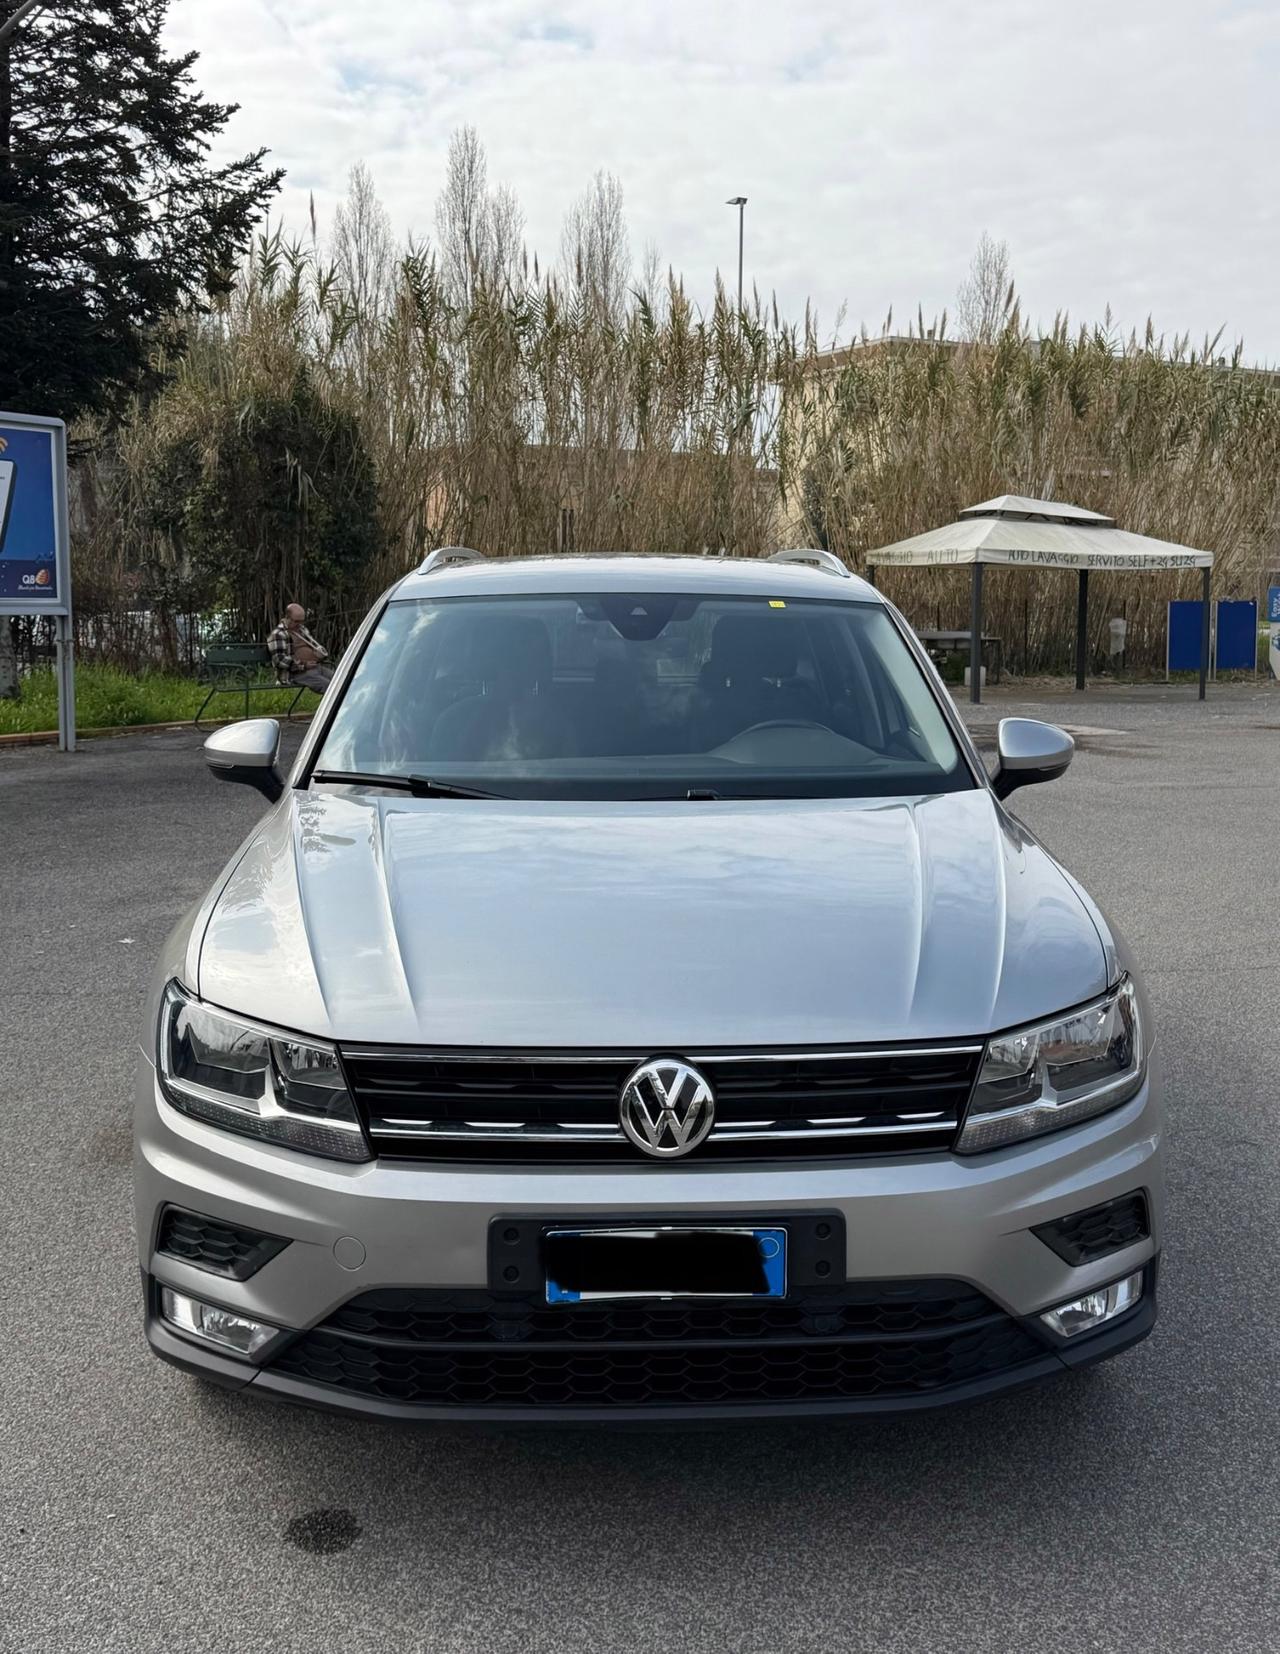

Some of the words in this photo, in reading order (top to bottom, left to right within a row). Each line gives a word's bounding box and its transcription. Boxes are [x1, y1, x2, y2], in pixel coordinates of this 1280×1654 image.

[927, 549, 959, 563] AUTO
[1031, 550, 1079, 565] LAVAGGIO
[1087, 554, 1124, 567] SERVITO
[22, 574, 36, 585] Q8
[623, 1061, 713, 1155] VW
